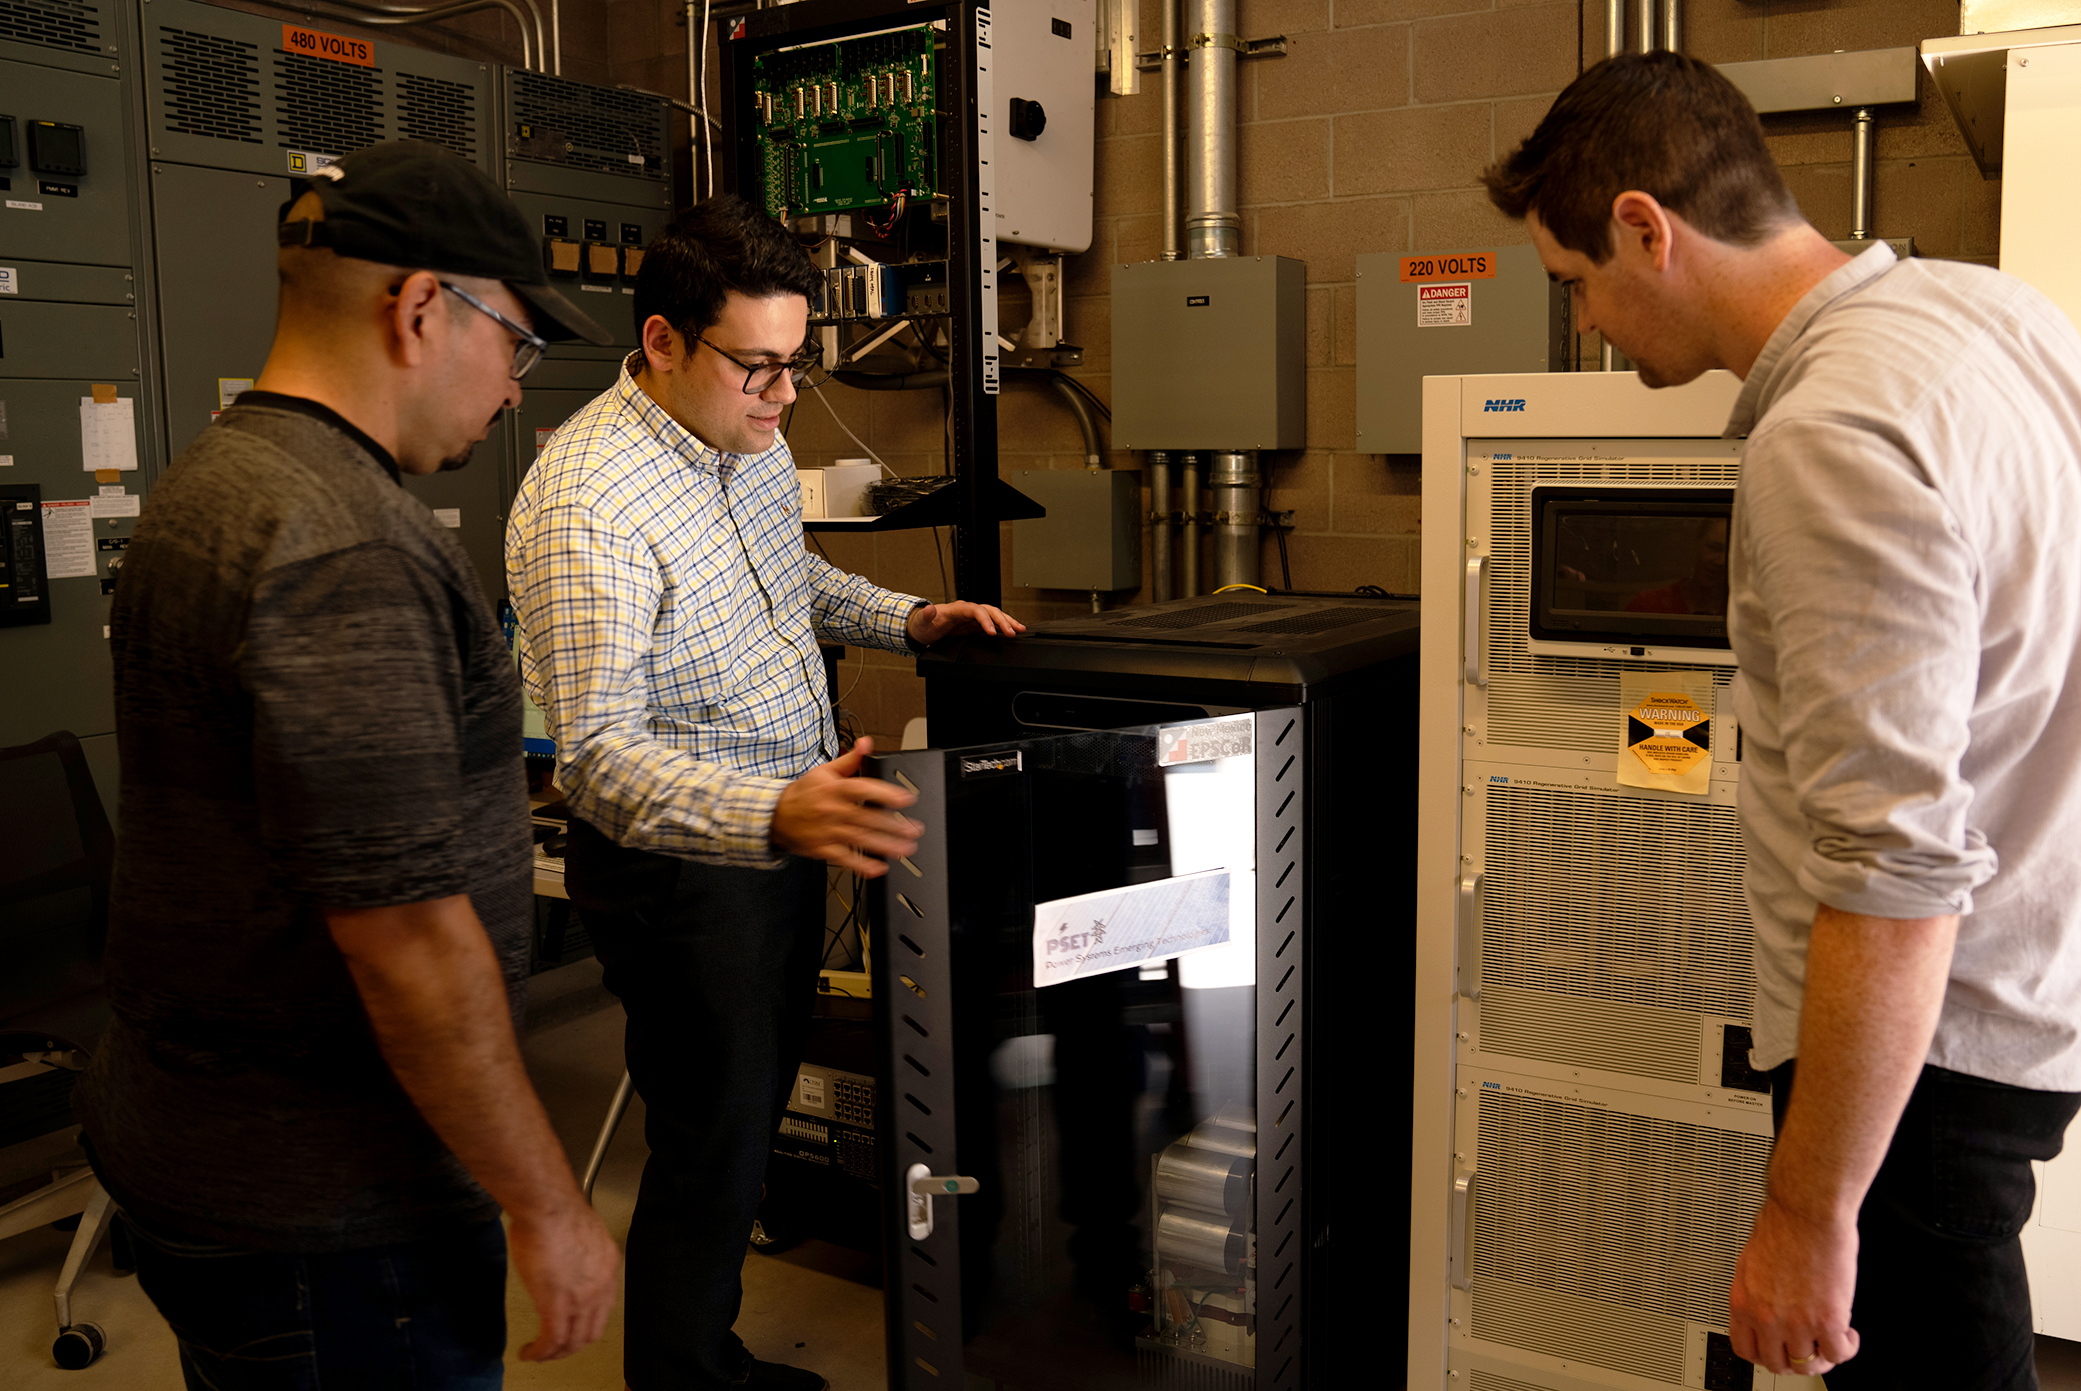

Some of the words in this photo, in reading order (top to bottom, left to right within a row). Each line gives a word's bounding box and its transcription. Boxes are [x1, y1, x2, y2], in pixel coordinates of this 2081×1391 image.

[291, 31, 316, 50] 480
[320, 36, 367, 60] VOLTS
[1409, 261, 1433, 276] 220
[1438, 257, 1486, 274] VOLTS
[1431, 288, 1466, 298] DANGER
[1484, 399, 1526, 412] NHR
[1493, 453, 1512, 461] NHR
[1639, 708, 1700, 722] WARNING
[1217, 721, 1252, 735] Mexico
[1191, 737, 1252, 759] EPSCoR
[1490, 775, 1509, 784] NHR
[1533, 780, 1572, 789] Regenerative
[1046, 932, 1090, 955] PSET
[1046, 957, 1073, 969] Power
[1075, 950, 1112, 965] Systems
[1114, 942, 1154, 956] Emerging
[1156, 928, 1210, 946] Technologies
[1482, 1081, 1501, 1090] NHR
[1525, 1089, 1562, 1099] Regenerative
[1579, 1098, 1608, 1106] Simulator
